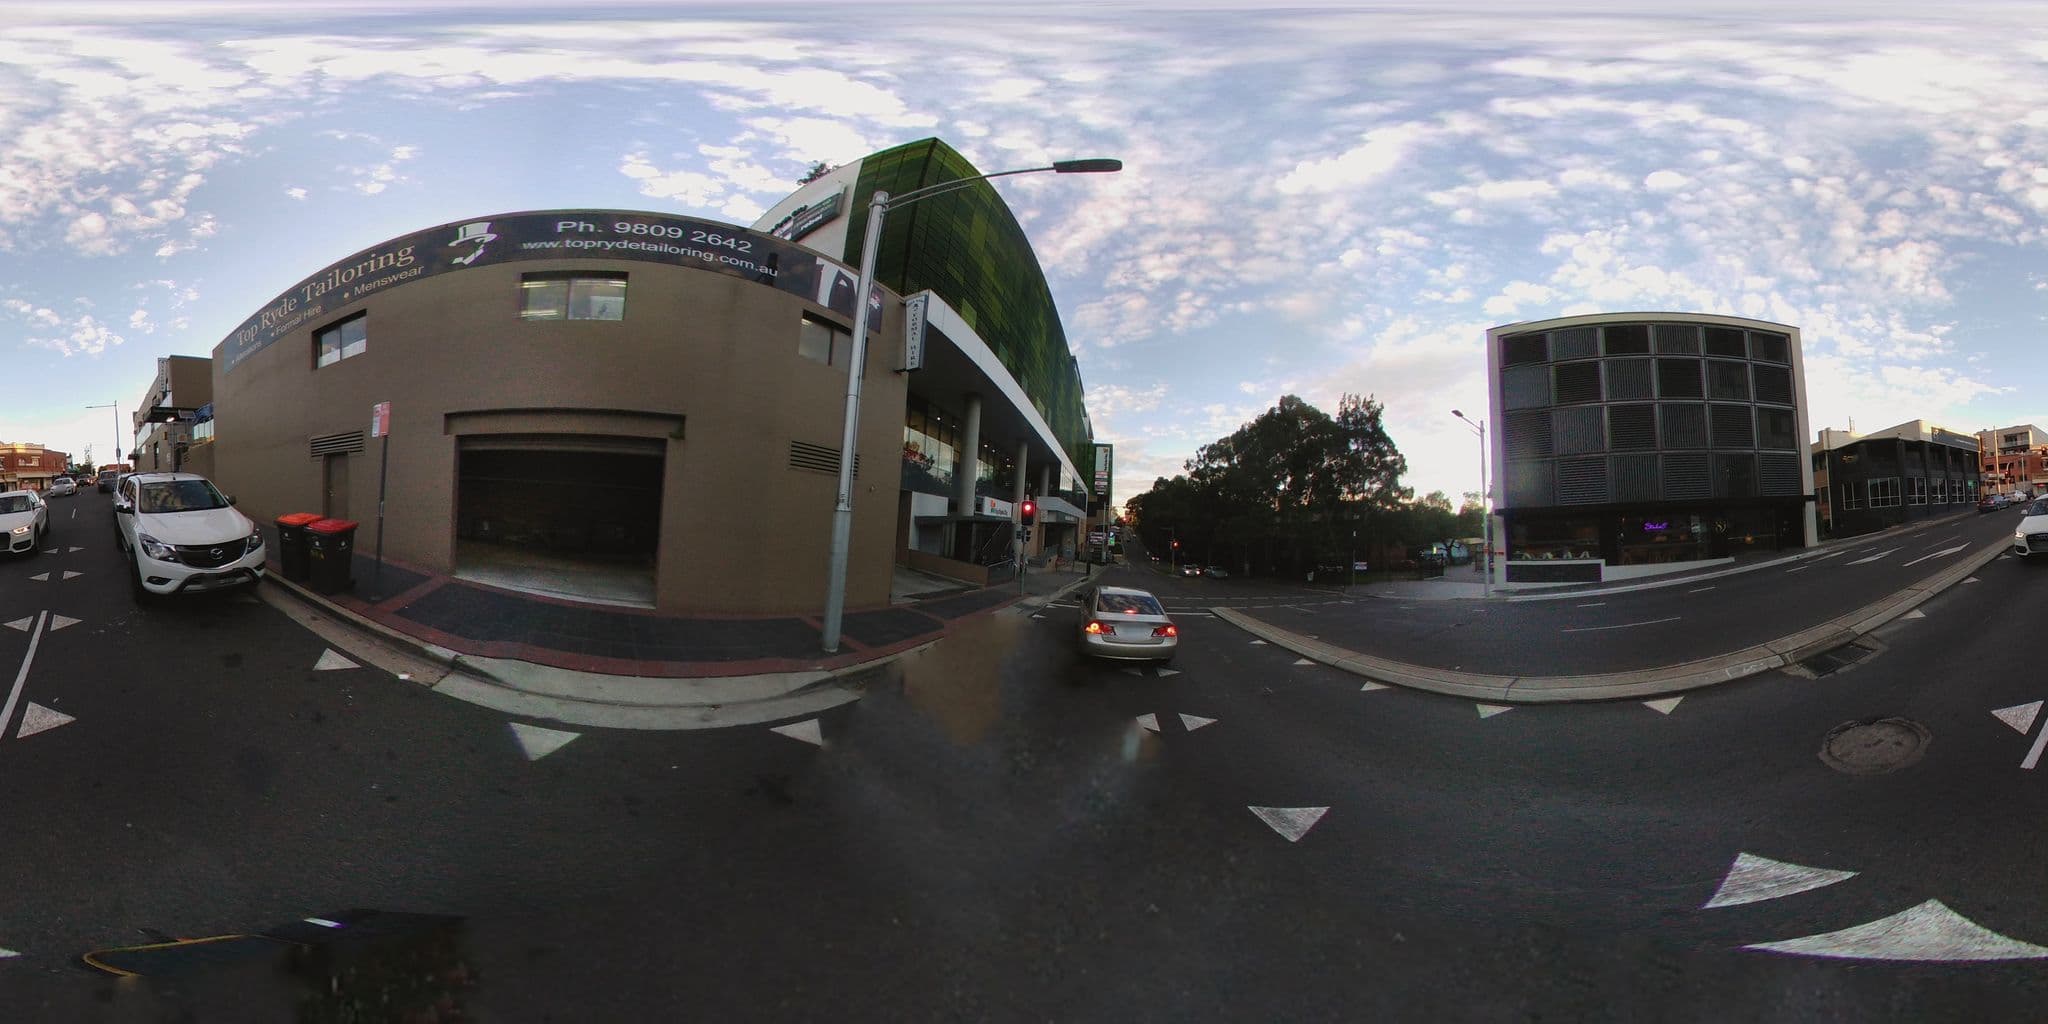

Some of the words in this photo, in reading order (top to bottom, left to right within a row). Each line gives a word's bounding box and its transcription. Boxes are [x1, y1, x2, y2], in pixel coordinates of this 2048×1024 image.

[556, 220, 603, 233] Ph.
[614, 221, 684, 239] 9809
[691, 229, 753, 254] 2642
[521, 238, 779, 278] www.toprydetailoring.com.au
[237, 324, 259, 346] Top
[261, 297, 297, 330] Ryde
[302, 244, 415, 304] Tailoring
[354, 265, 425, 296] Menswear
[276, 314, 302, 336] Formal
[303, 304, 322, 320] Hire
